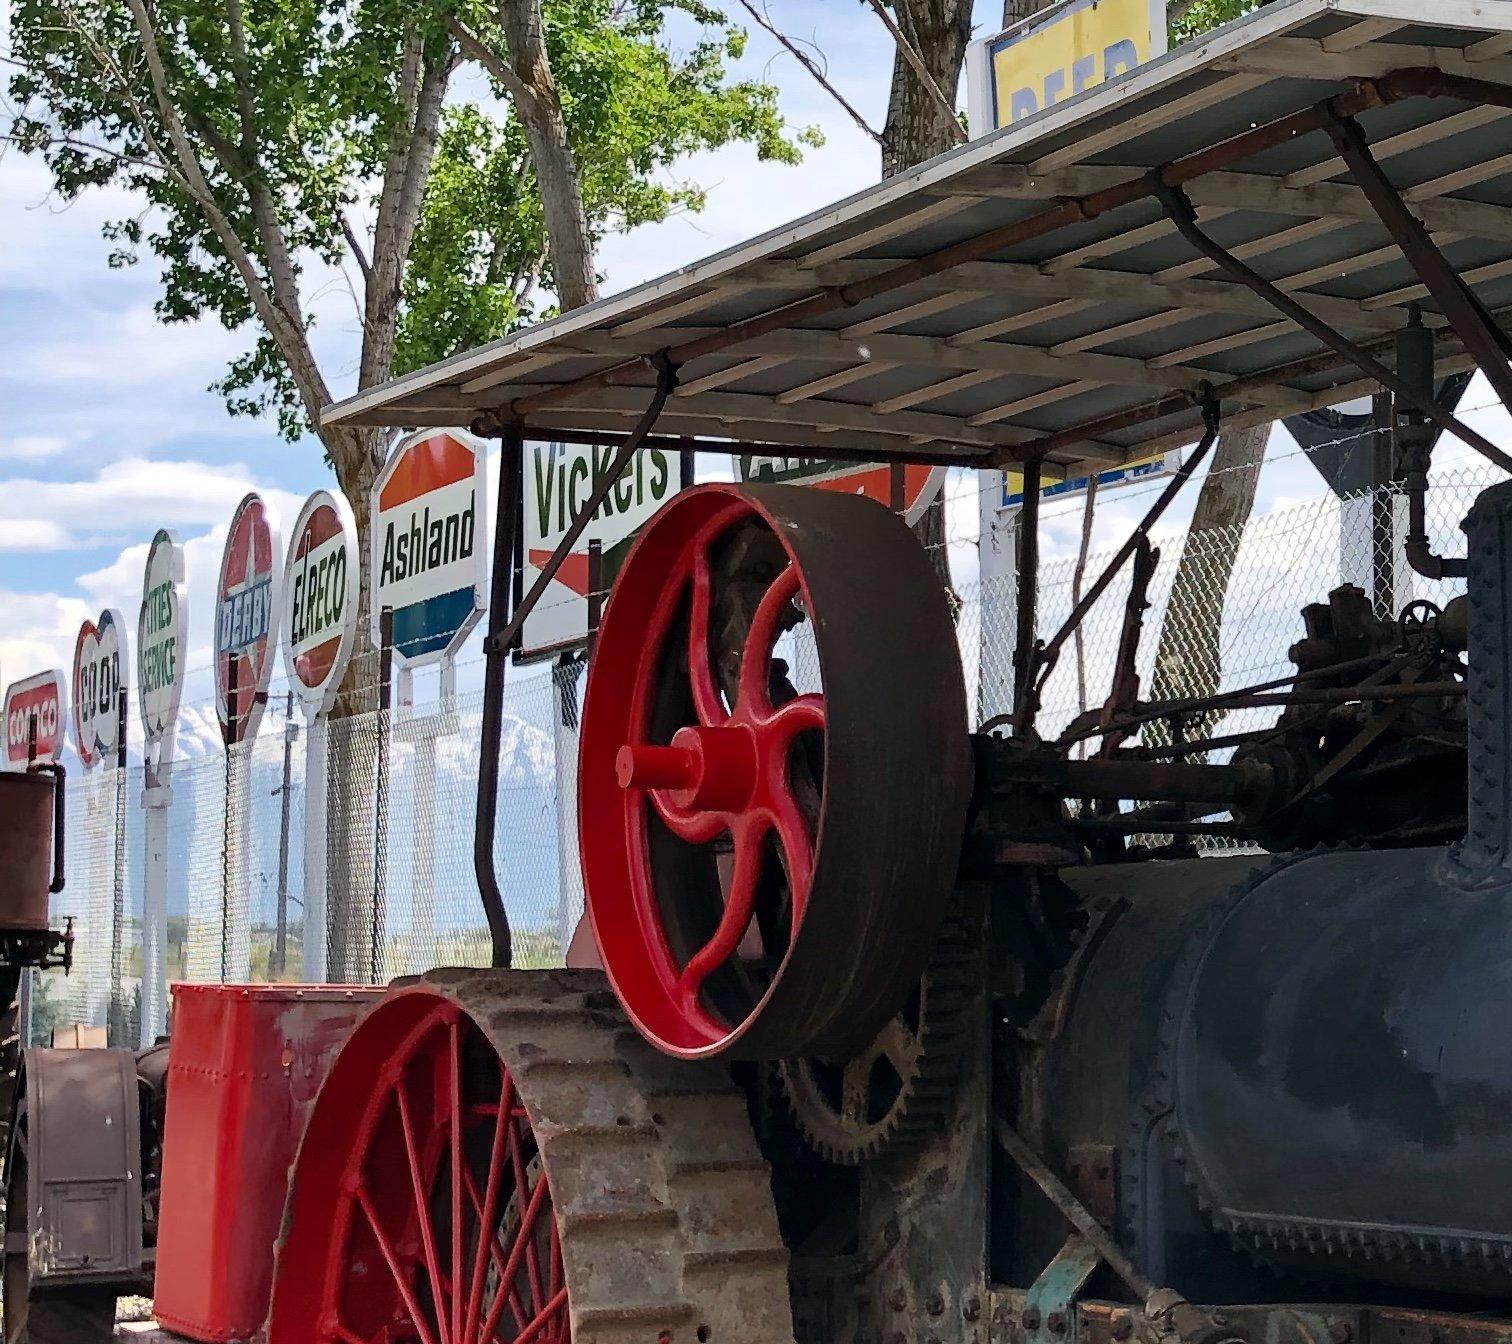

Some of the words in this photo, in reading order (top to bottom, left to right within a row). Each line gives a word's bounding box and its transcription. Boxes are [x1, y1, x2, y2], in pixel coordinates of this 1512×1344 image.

[379, 488, 476, 588] Ashland
[533, 442, 669, 539] Vickers
[220, 582, 272, 652] DERBY
